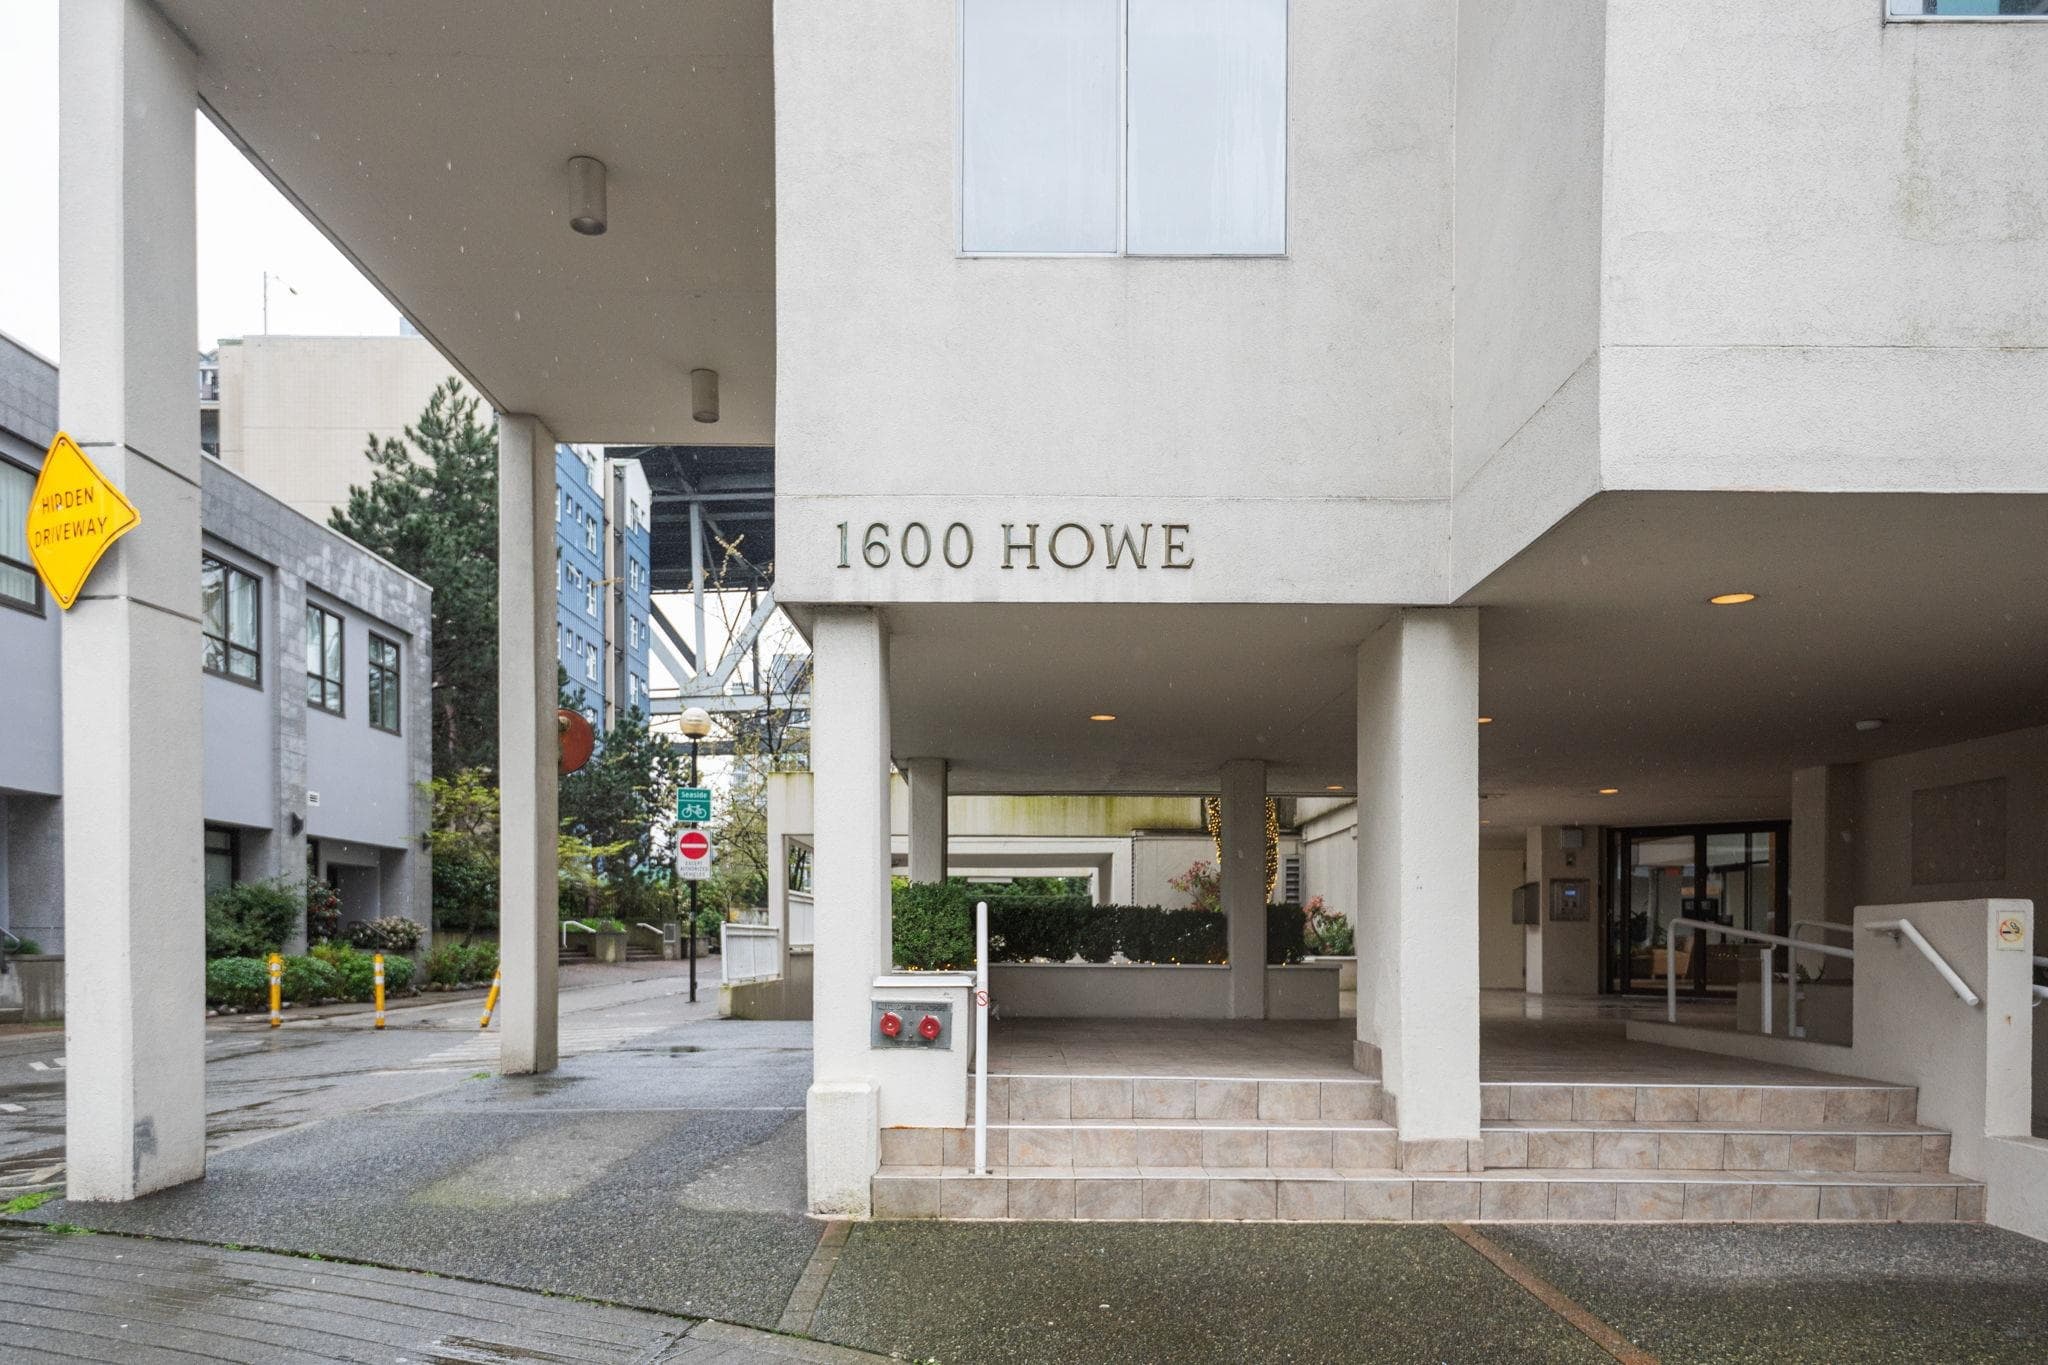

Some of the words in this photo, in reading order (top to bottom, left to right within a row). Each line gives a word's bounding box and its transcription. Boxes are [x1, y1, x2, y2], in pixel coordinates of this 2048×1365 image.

[35, 517, 108, 548] DRIVEWAY
[836, 521, 974, 569] 1600
[1001, 522, 1195, 569] HOWE
[681, 791, 708, 799] Seaside
